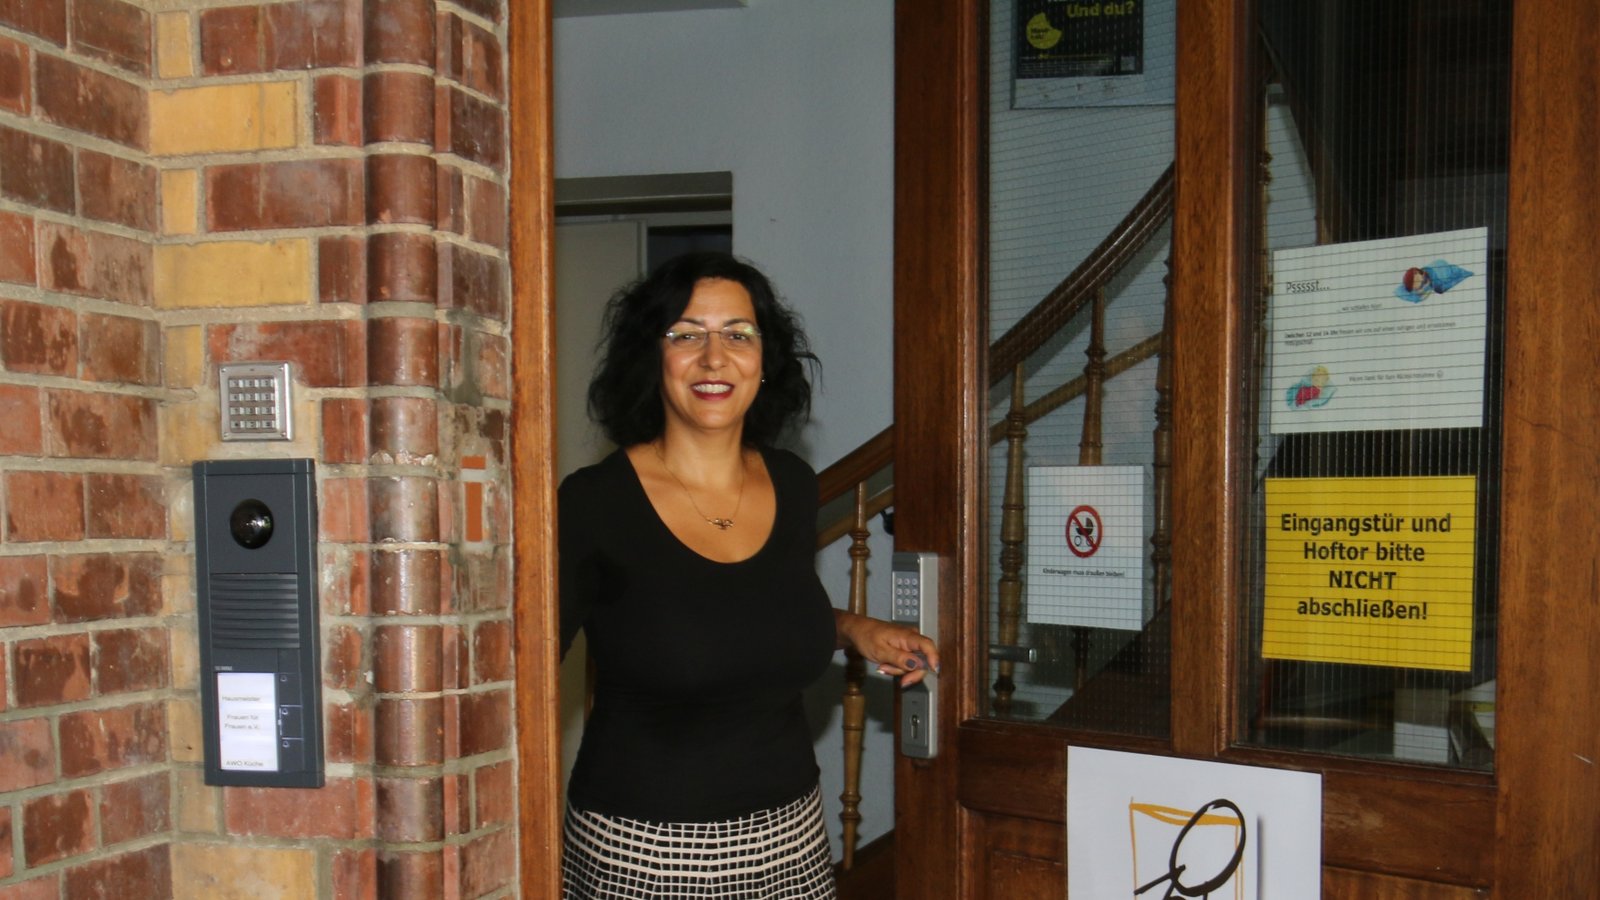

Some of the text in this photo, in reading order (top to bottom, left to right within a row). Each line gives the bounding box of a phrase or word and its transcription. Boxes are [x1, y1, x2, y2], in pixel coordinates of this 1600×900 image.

[1066, 0, 1135, 18] Und du?
[1281, 513, 1451, 536] Eingangstür und
[1303, 541, 1425, 562] Hoftor bitte
[1328, 570, 1397, 589] NICHT
[1297, 597, 1428, 620] abschließen!
